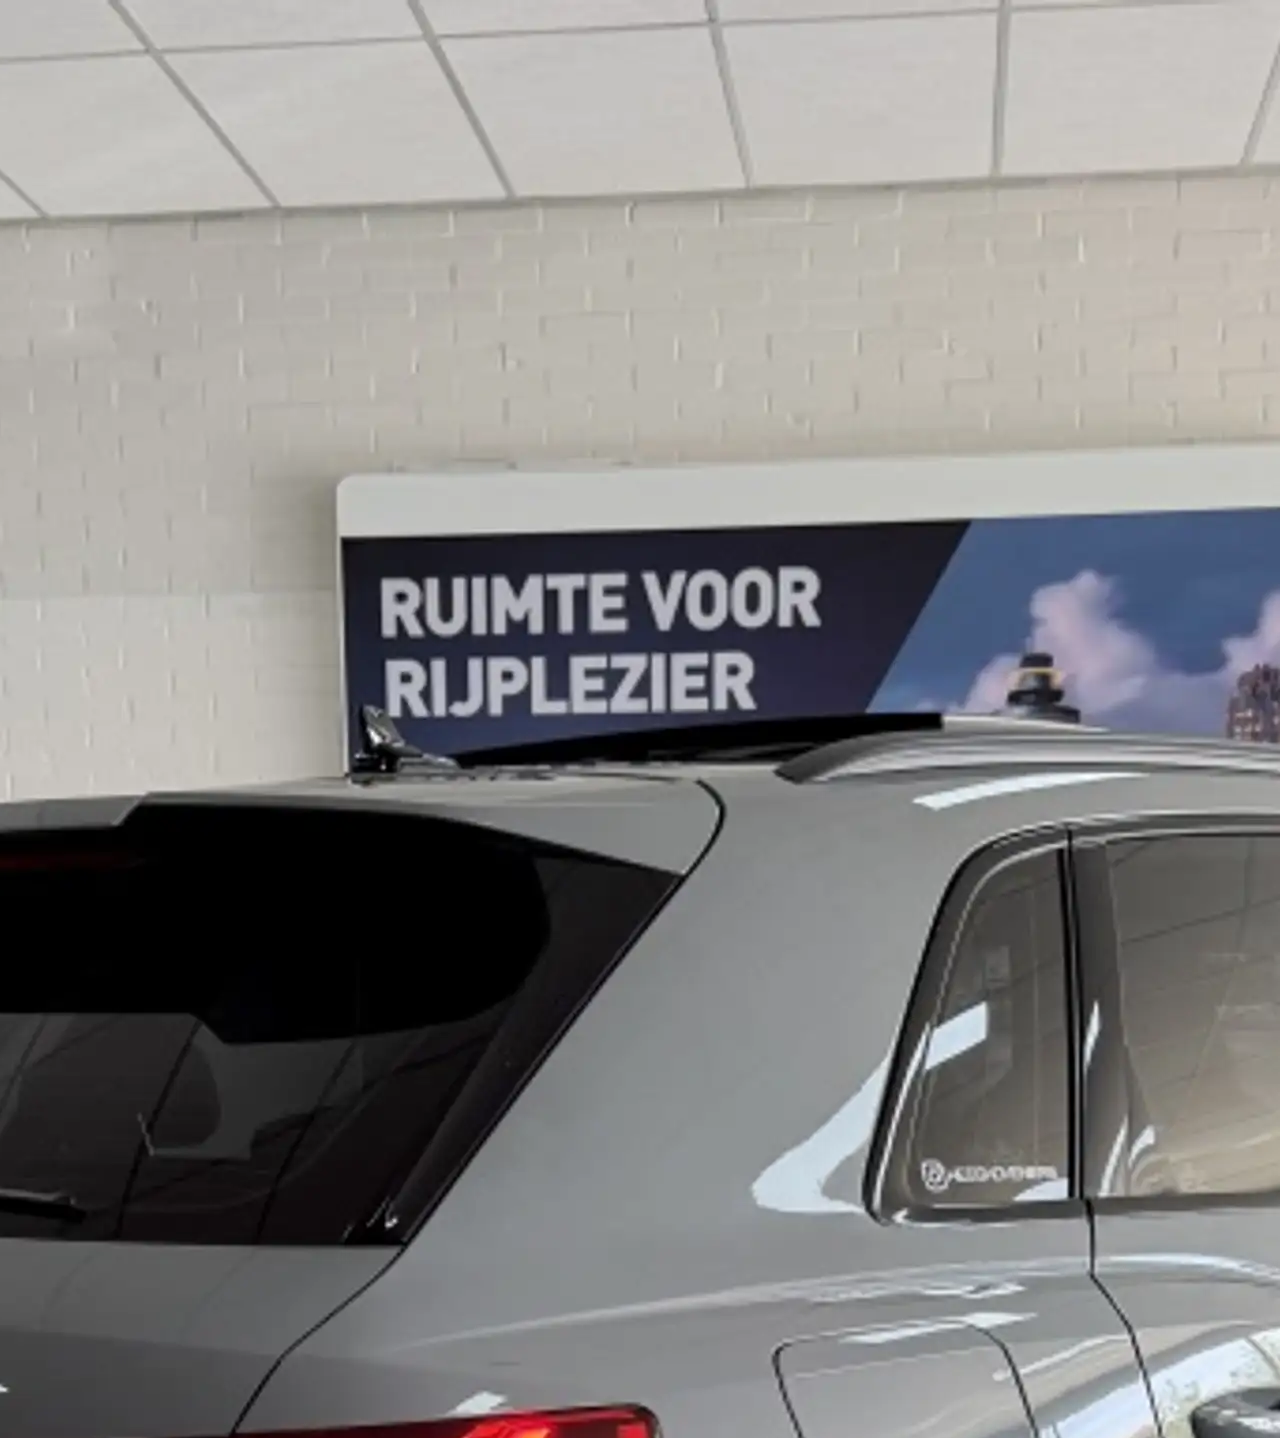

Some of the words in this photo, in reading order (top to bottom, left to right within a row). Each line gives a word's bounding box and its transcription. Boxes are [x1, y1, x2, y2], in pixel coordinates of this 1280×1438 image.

[380, 573, 629, 638] RUIMTE
[641, 565, 822, 632] VOOR
[385, 650, 758, 718] RIJPLEZIER
